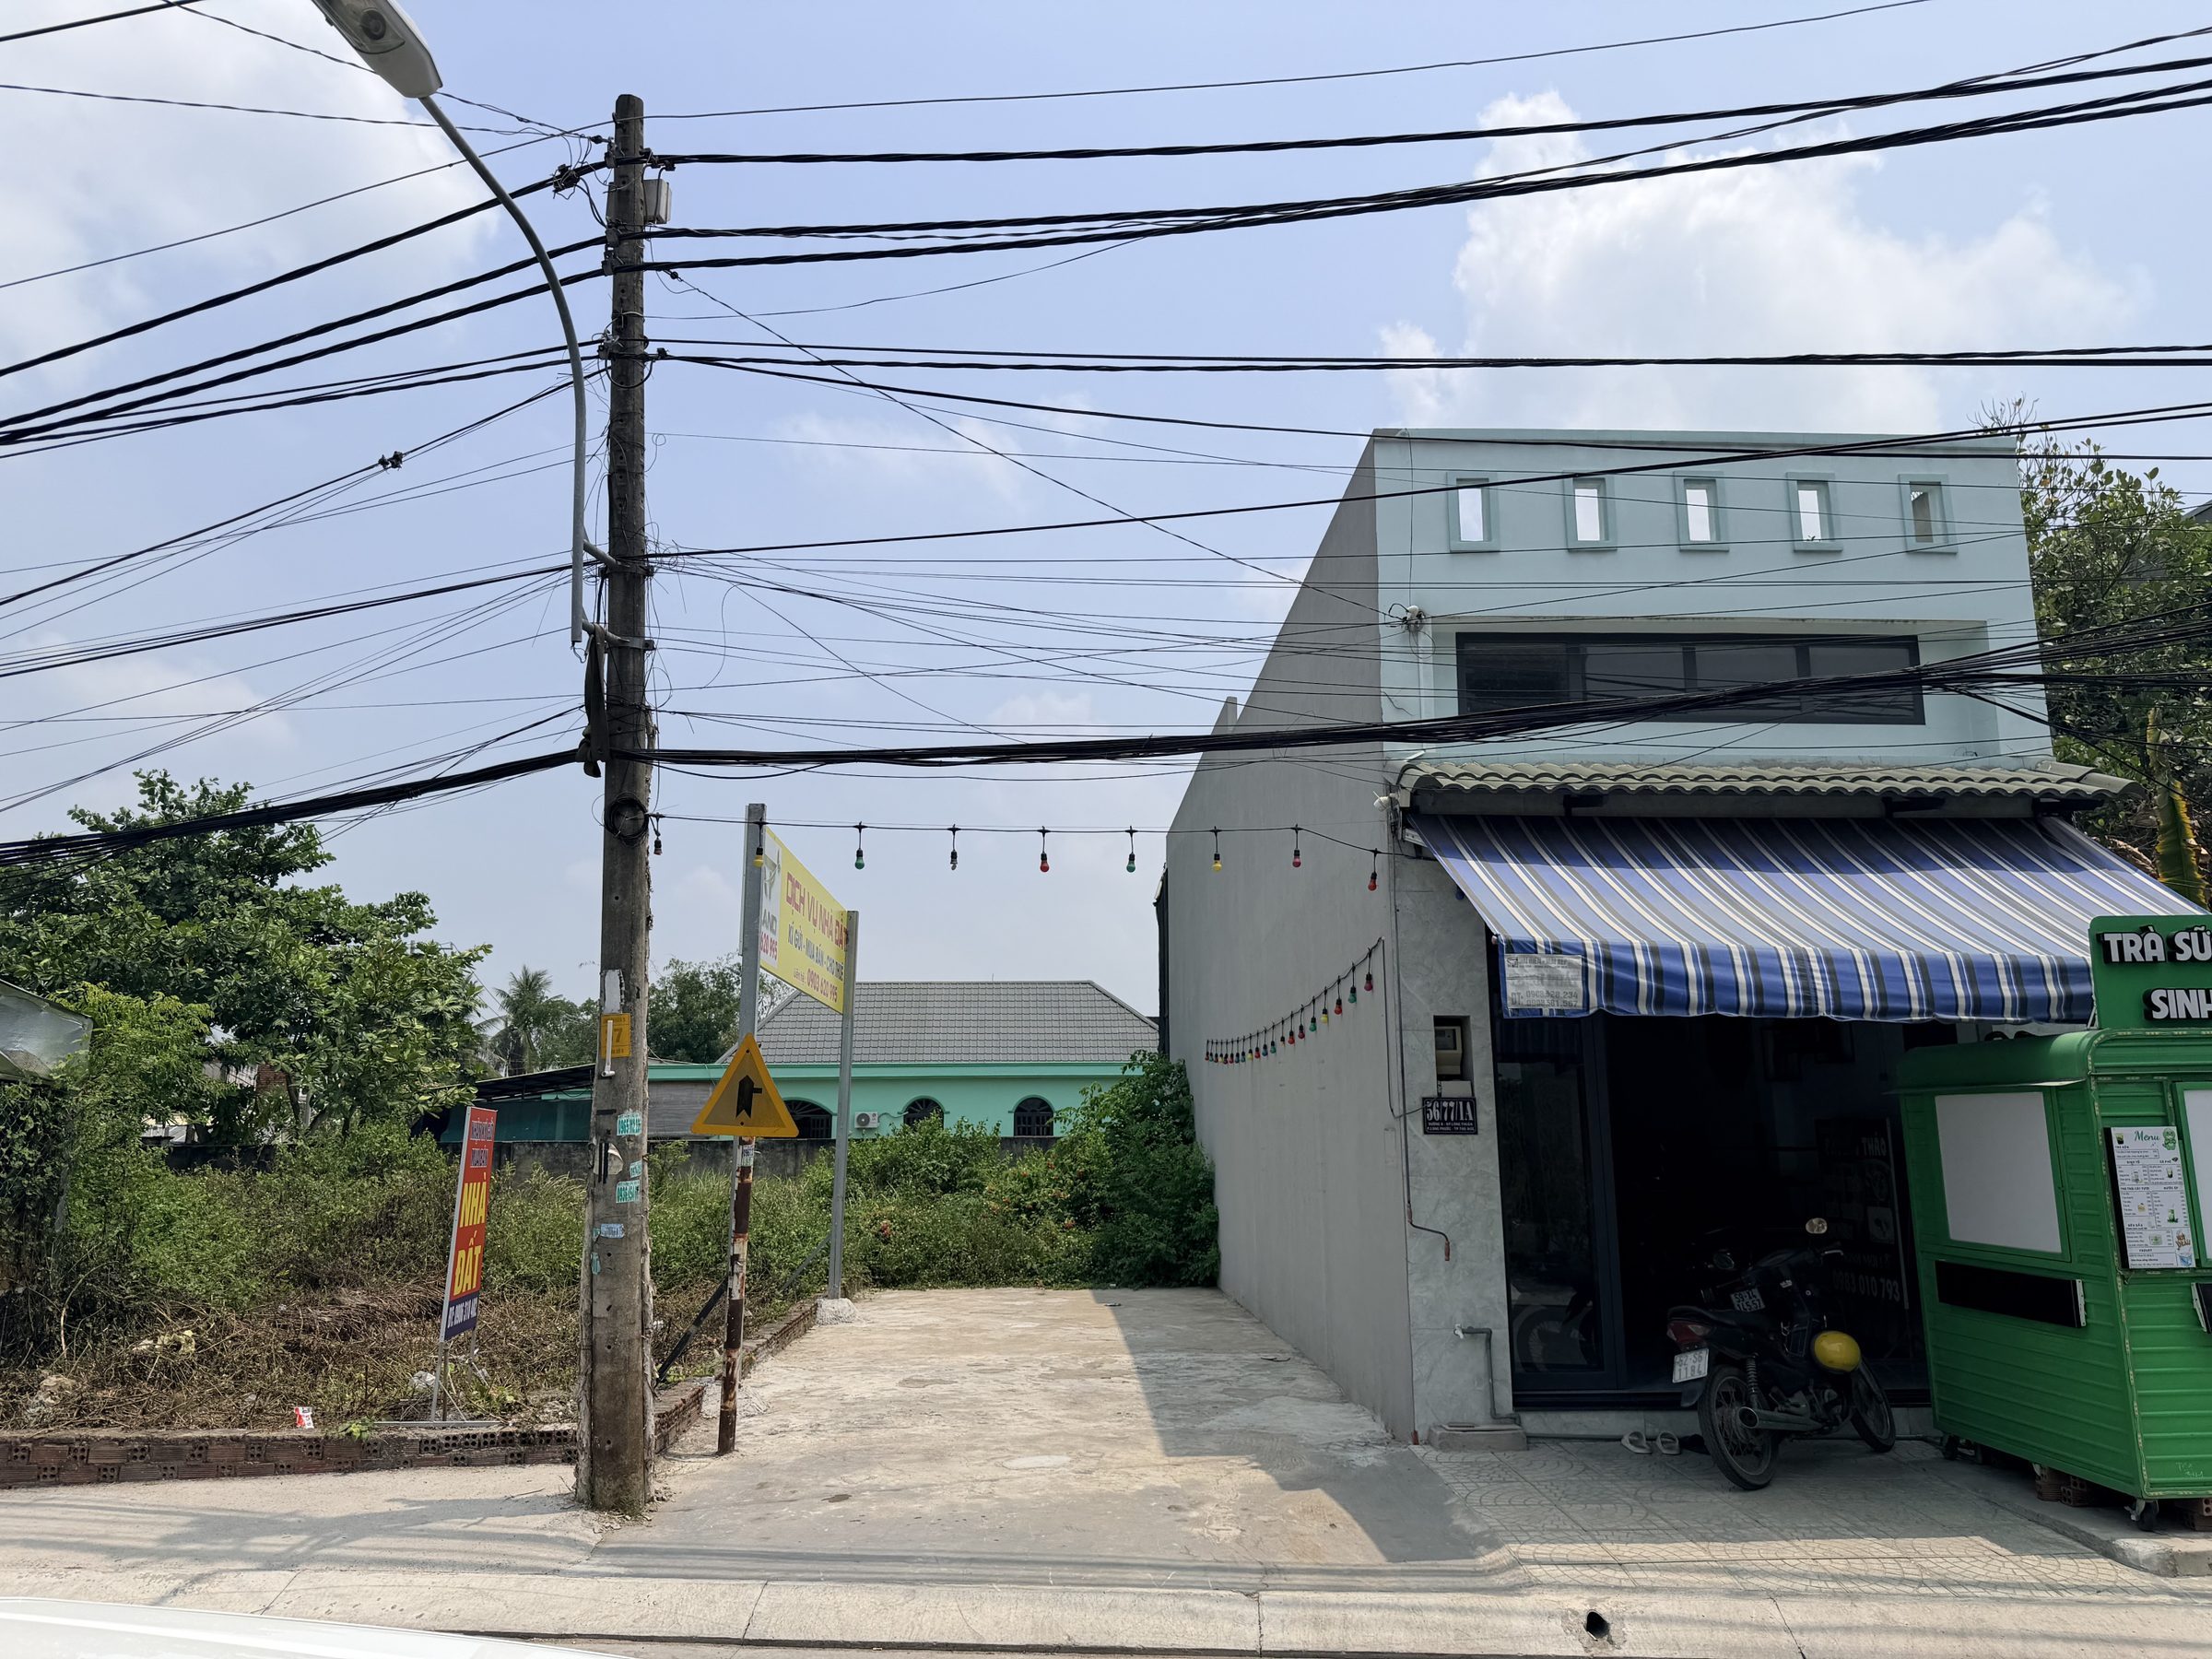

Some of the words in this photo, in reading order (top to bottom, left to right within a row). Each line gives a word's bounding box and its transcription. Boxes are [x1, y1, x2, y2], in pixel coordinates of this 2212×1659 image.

[786, 871, 806, 916] DỊCH
[807, 891, 818, 934] VỤ
[819, 904, 833, 942] NHÀ
[2103, 925, 2166, 963] TRÀ
[807, 968, 819, 993] 0903
[2134, 1130, 2159, 1142] Menu
[460, 1172, 487, 1228] NHÀ
[453, 1230, 482, 1297] ĐẤT
[1858, 1274, 1877, 1298] 010
[1879, 1277, 1900, 1302] 793
